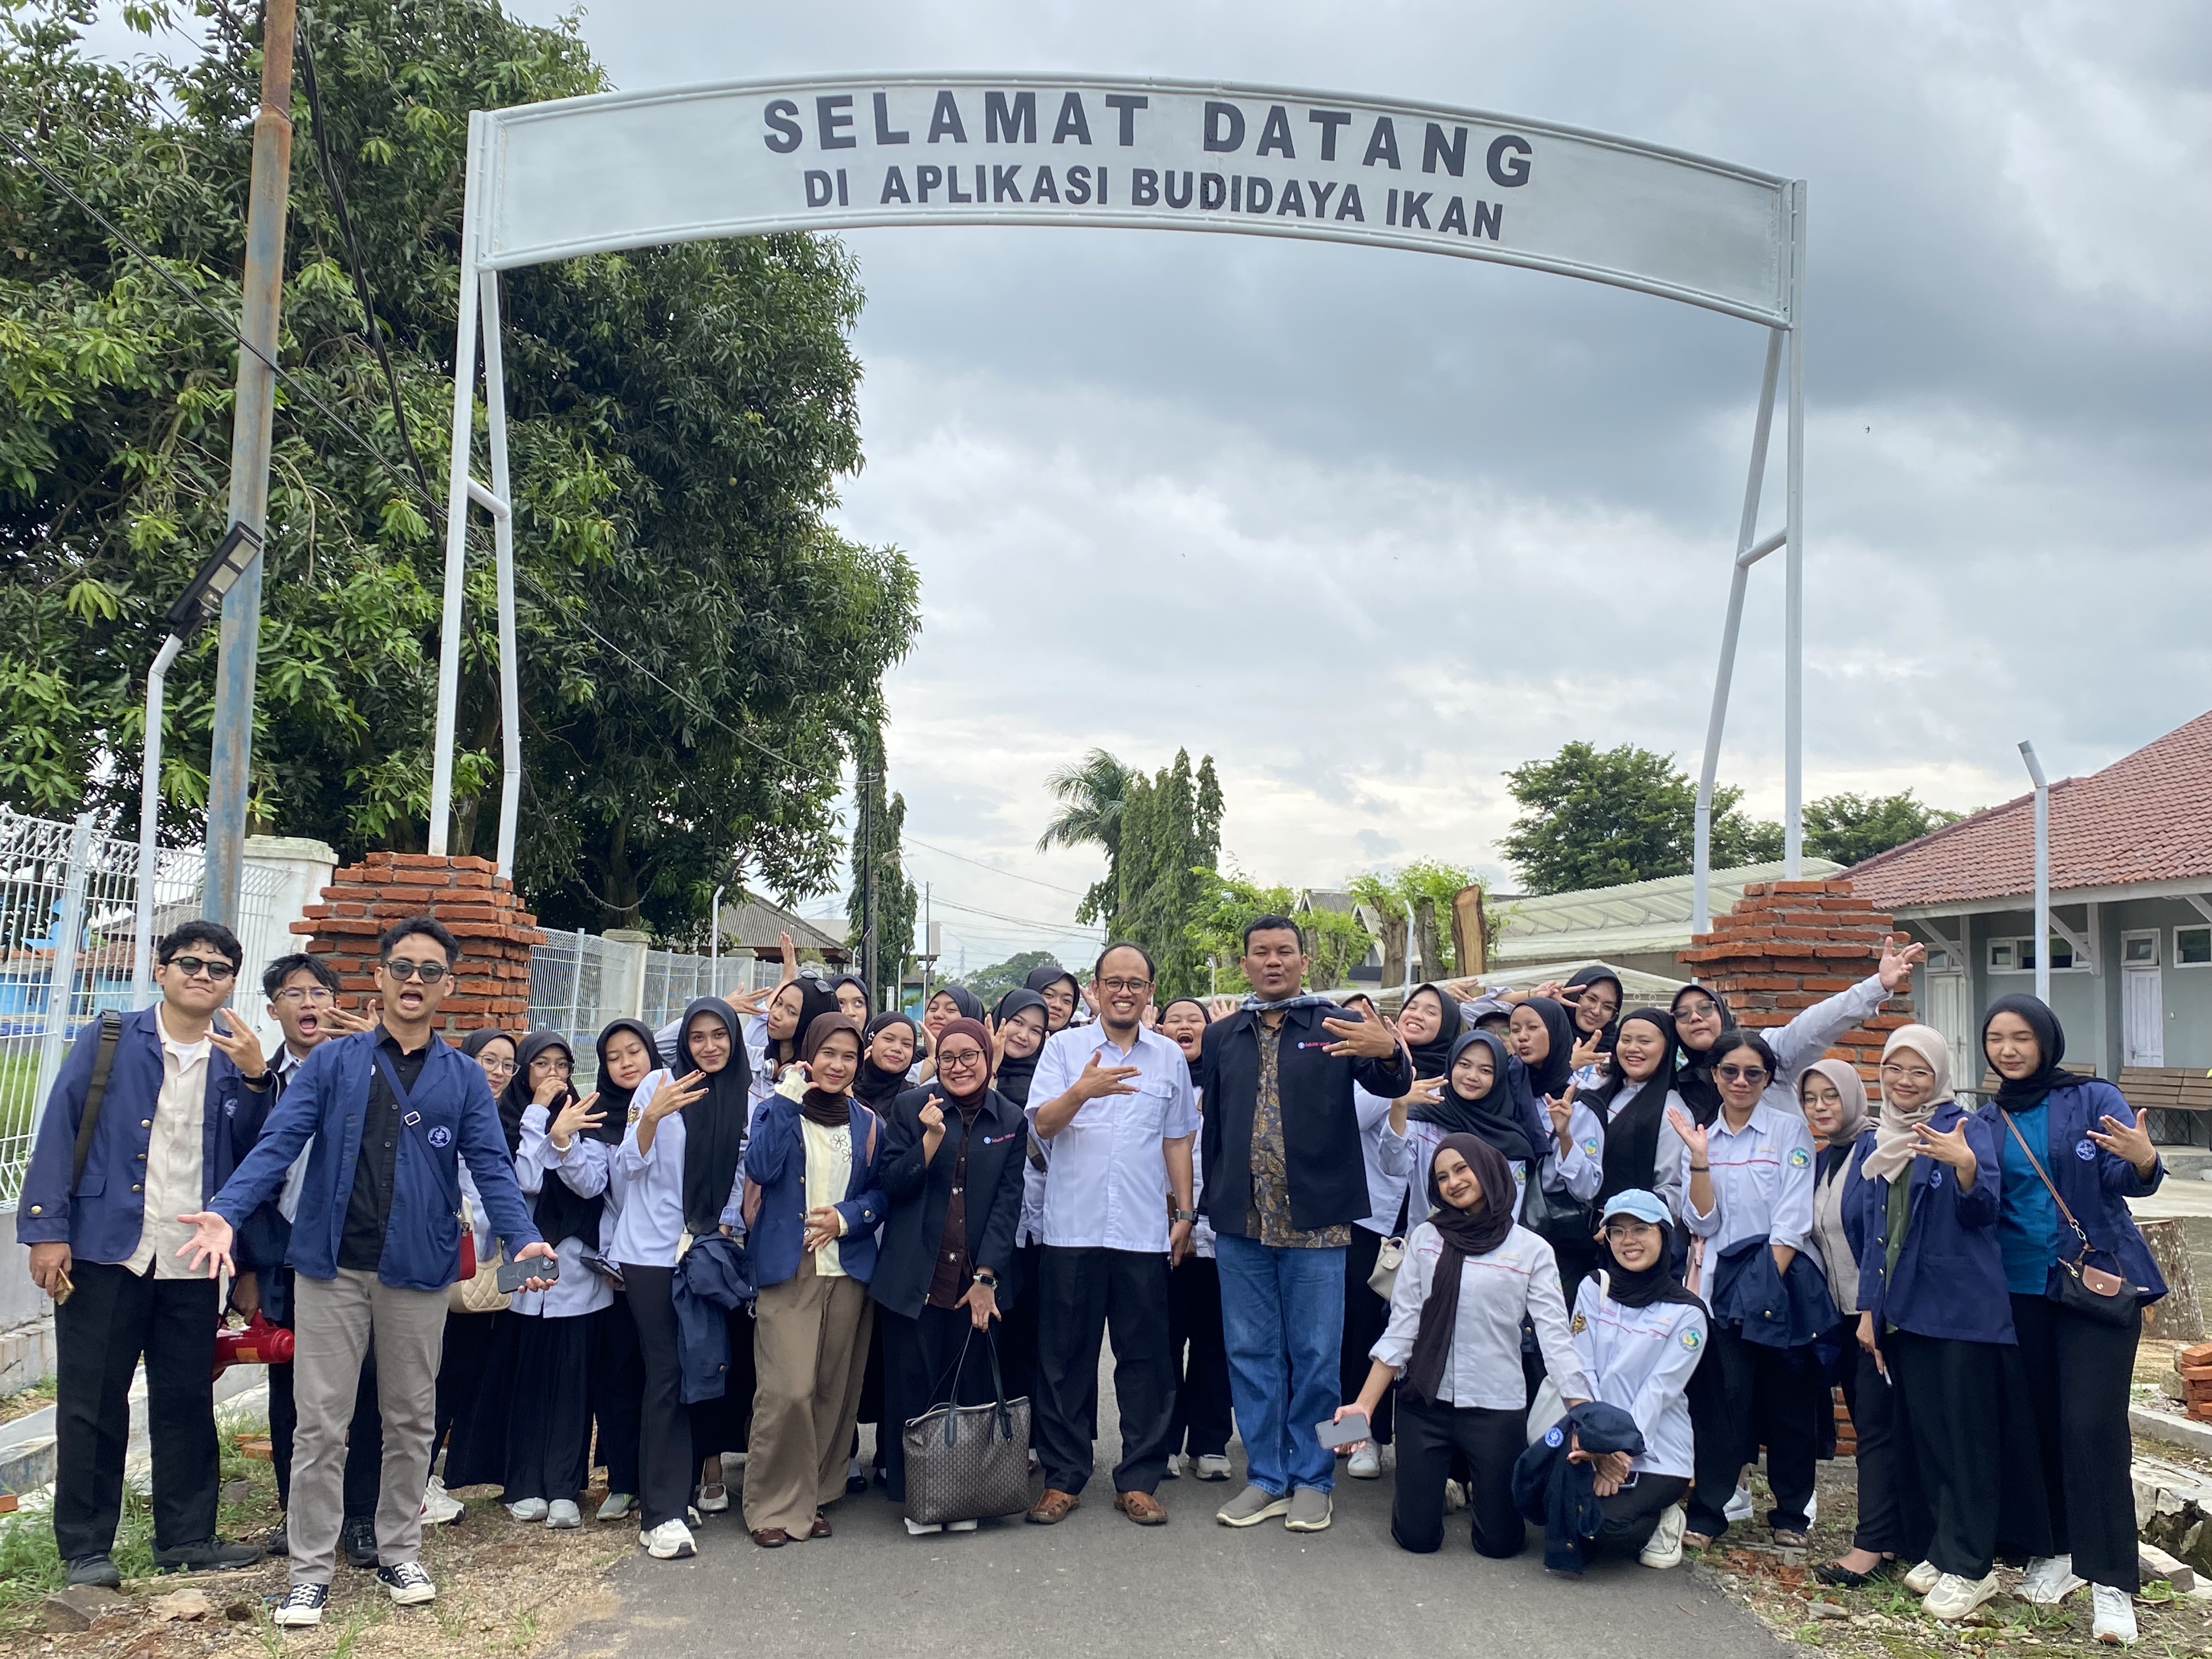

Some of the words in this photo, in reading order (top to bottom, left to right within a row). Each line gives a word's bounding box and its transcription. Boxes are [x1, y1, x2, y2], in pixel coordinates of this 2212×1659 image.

[764, 91, 1148, 154] SELAMAT
[1203, 101, 1532, 188] DATANG
[804, 168, 849, 208] DI
[880, 165, 1107, 205] APLIKASI
[1132, 168, 1365, 222] BUDIDAYA
[1386, 188, 1503, 241] IKAN
